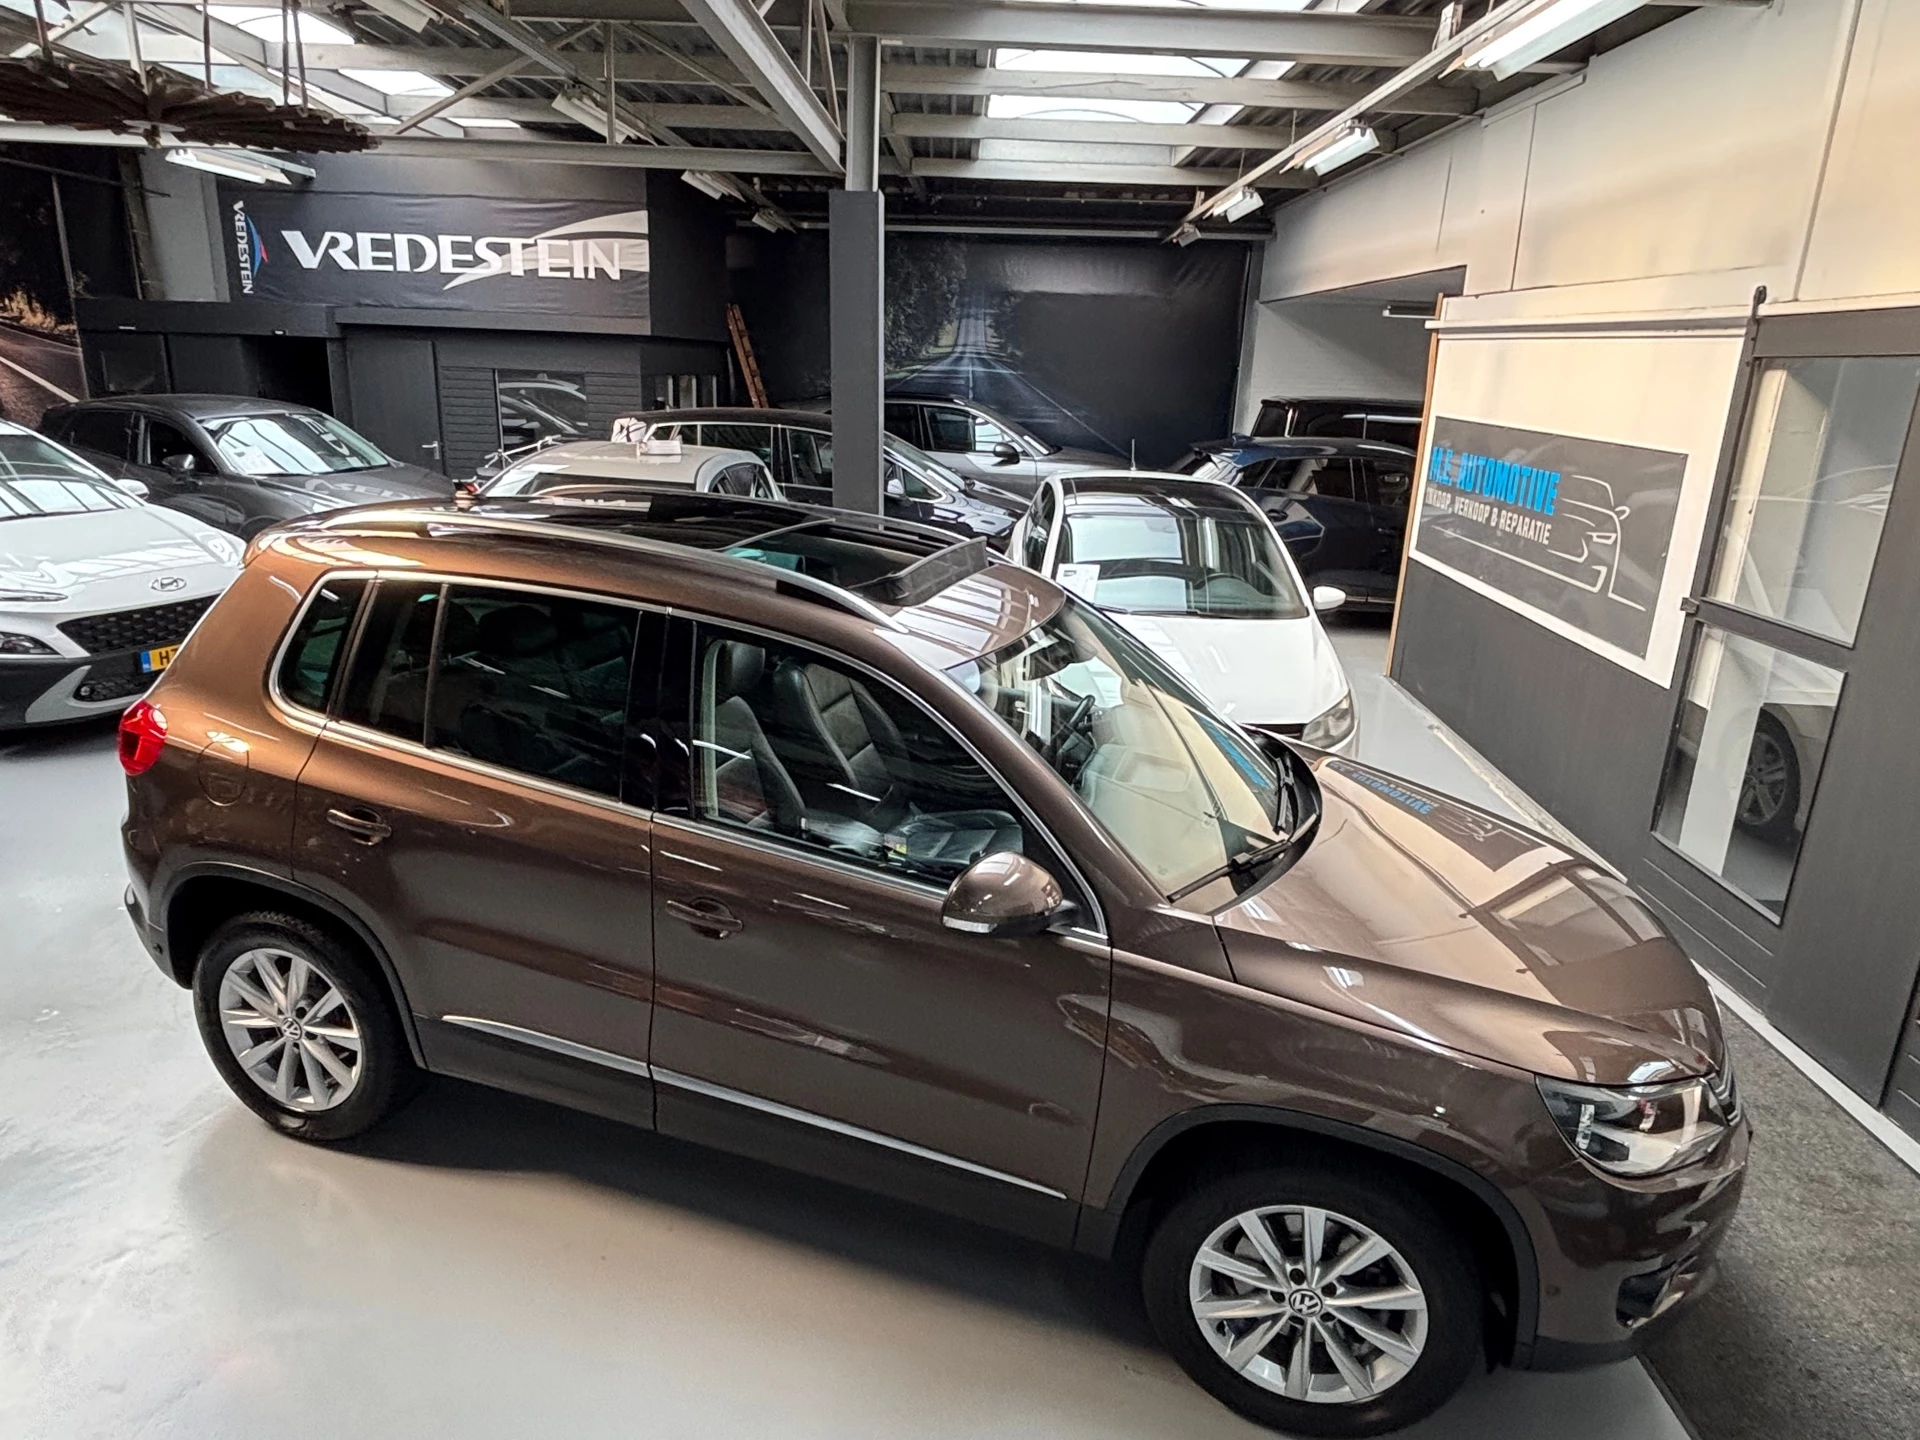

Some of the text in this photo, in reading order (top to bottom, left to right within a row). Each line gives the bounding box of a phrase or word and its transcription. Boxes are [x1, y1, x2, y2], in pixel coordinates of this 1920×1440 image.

[233, 200, 254, 294] VREDESTEIN
[281, 230, 621, 281] VREDESTEIN
[1456, 452, 1560, 516] AUTOMOTIVE
[1454, 496, 1491, 524] VERKOOP
[1499, 509, 1552, 545] REPARATIE
